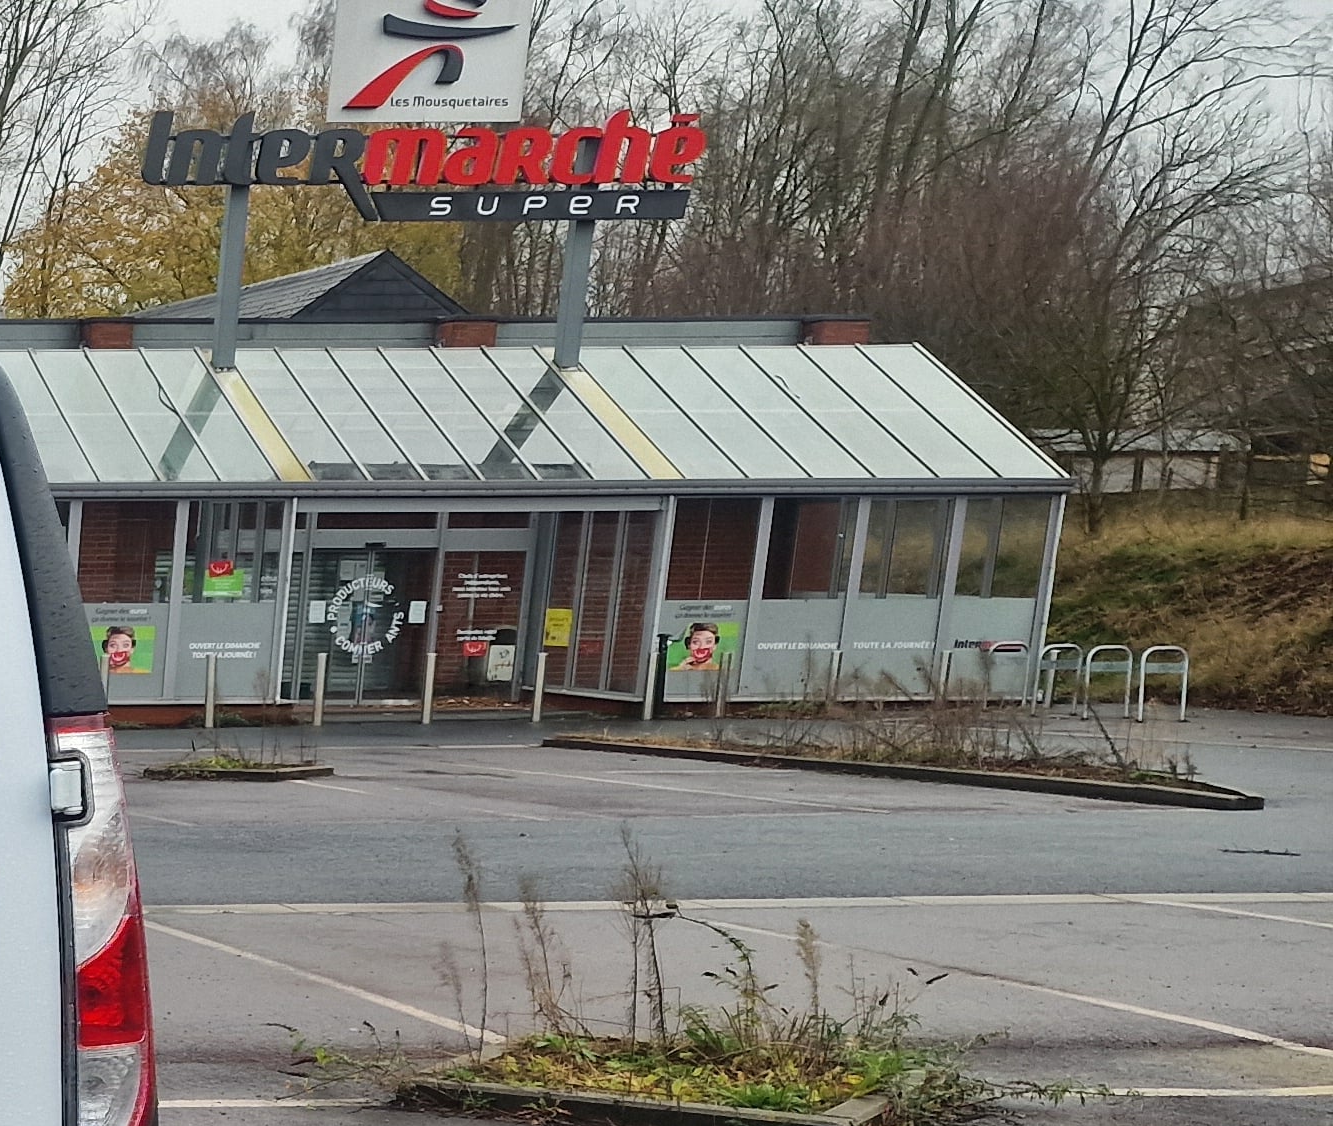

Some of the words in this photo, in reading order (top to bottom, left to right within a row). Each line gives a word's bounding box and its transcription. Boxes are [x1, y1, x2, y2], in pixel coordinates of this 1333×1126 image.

[412, 95, 509, 109] Mousquetaires
[141, 109, 707, 221] Intermarché
[429, 195, 641, 217] SUPER
[326, 576, 395, 621] PRODUCTEURS
[189, 642, 217, 650] OUVERT
[757, 642, 788, 650] OUVERT
[788, 642, 796, 650] LE
[853, 641, 879, 649] TOUTE
[881, 641, 891, 649] LA
[891, 640, 930, 649] JOURNÉE
